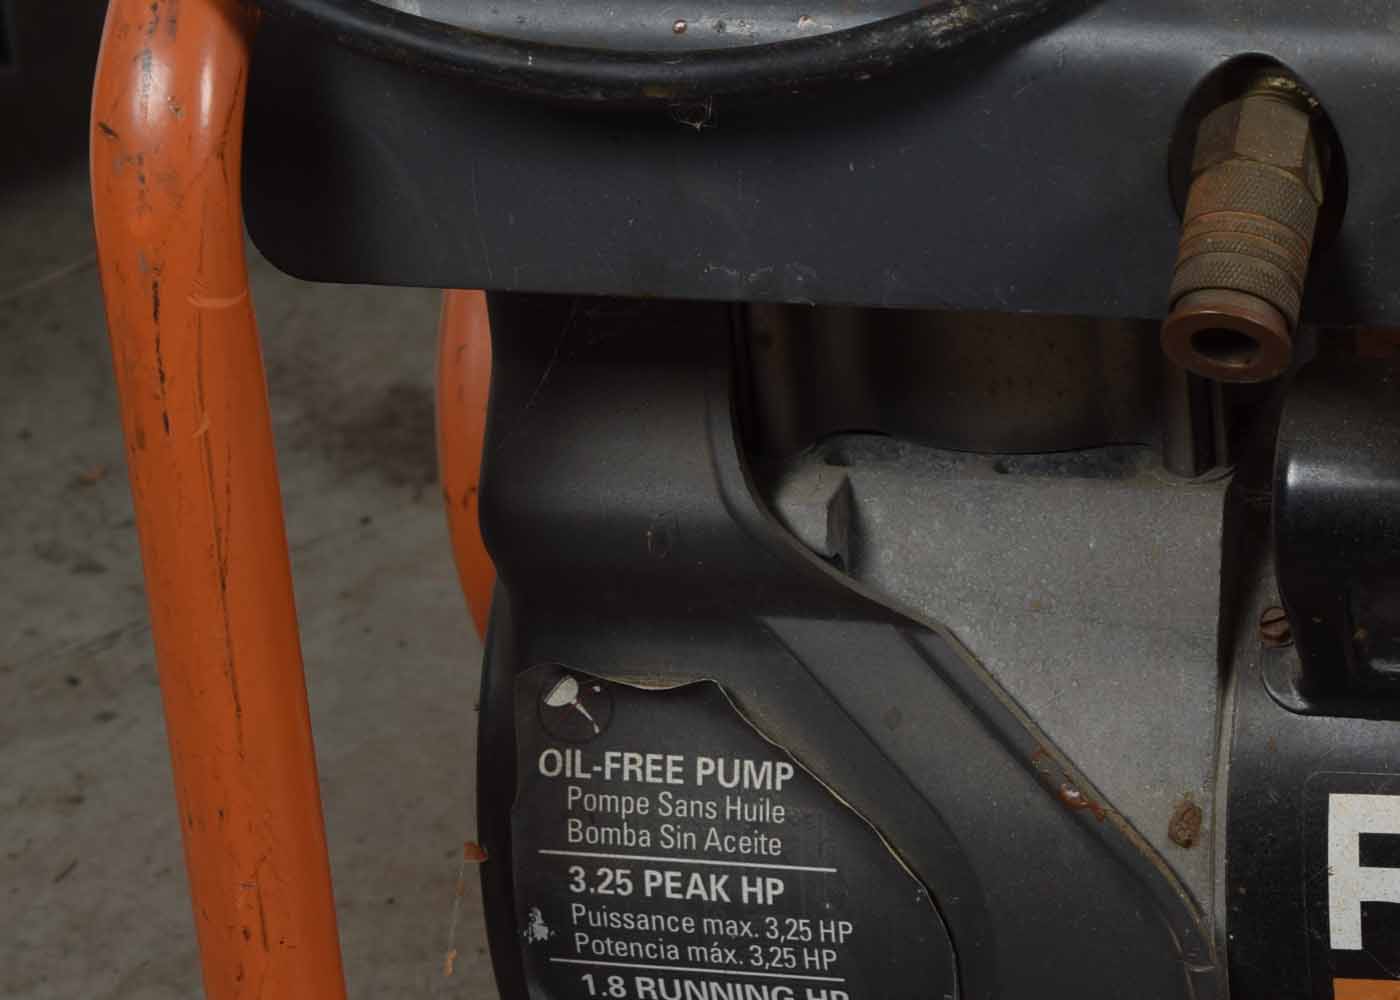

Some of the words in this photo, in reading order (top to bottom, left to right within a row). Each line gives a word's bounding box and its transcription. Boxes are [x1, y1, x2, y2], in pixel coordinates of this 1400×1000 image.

[538, 748, 684, 785] OIL-FREE
[696, 756, 794, 791] PUMP
[567, 786, 649, 822] Pompe
[658, 793, 717, 819] Sans
[725, 797, 785, 824] Huile
[567, 820, 651, 847] Bomba
[660, 824, 696, 850] Sin
[704, 828, 783, 856] Aceite
[568, 866, 633, 896] 3.25
[644, 870, 730, 902] PEAK
[741, 876, 785, 905] HP
[571, 903, 695, 934] Puissance
[703, 915, 759, 939] max.
[765, 917, 812, 945] 3,25
[819, 920, 853, 944] HP
[574, 933, 680, 961] Potencia
[688, 941, 744, 965] máx.
[749, 945, 797, 972] 3,25
[803, 949, 837, 970] HP
[581, 974, 626, 998] 1.8
